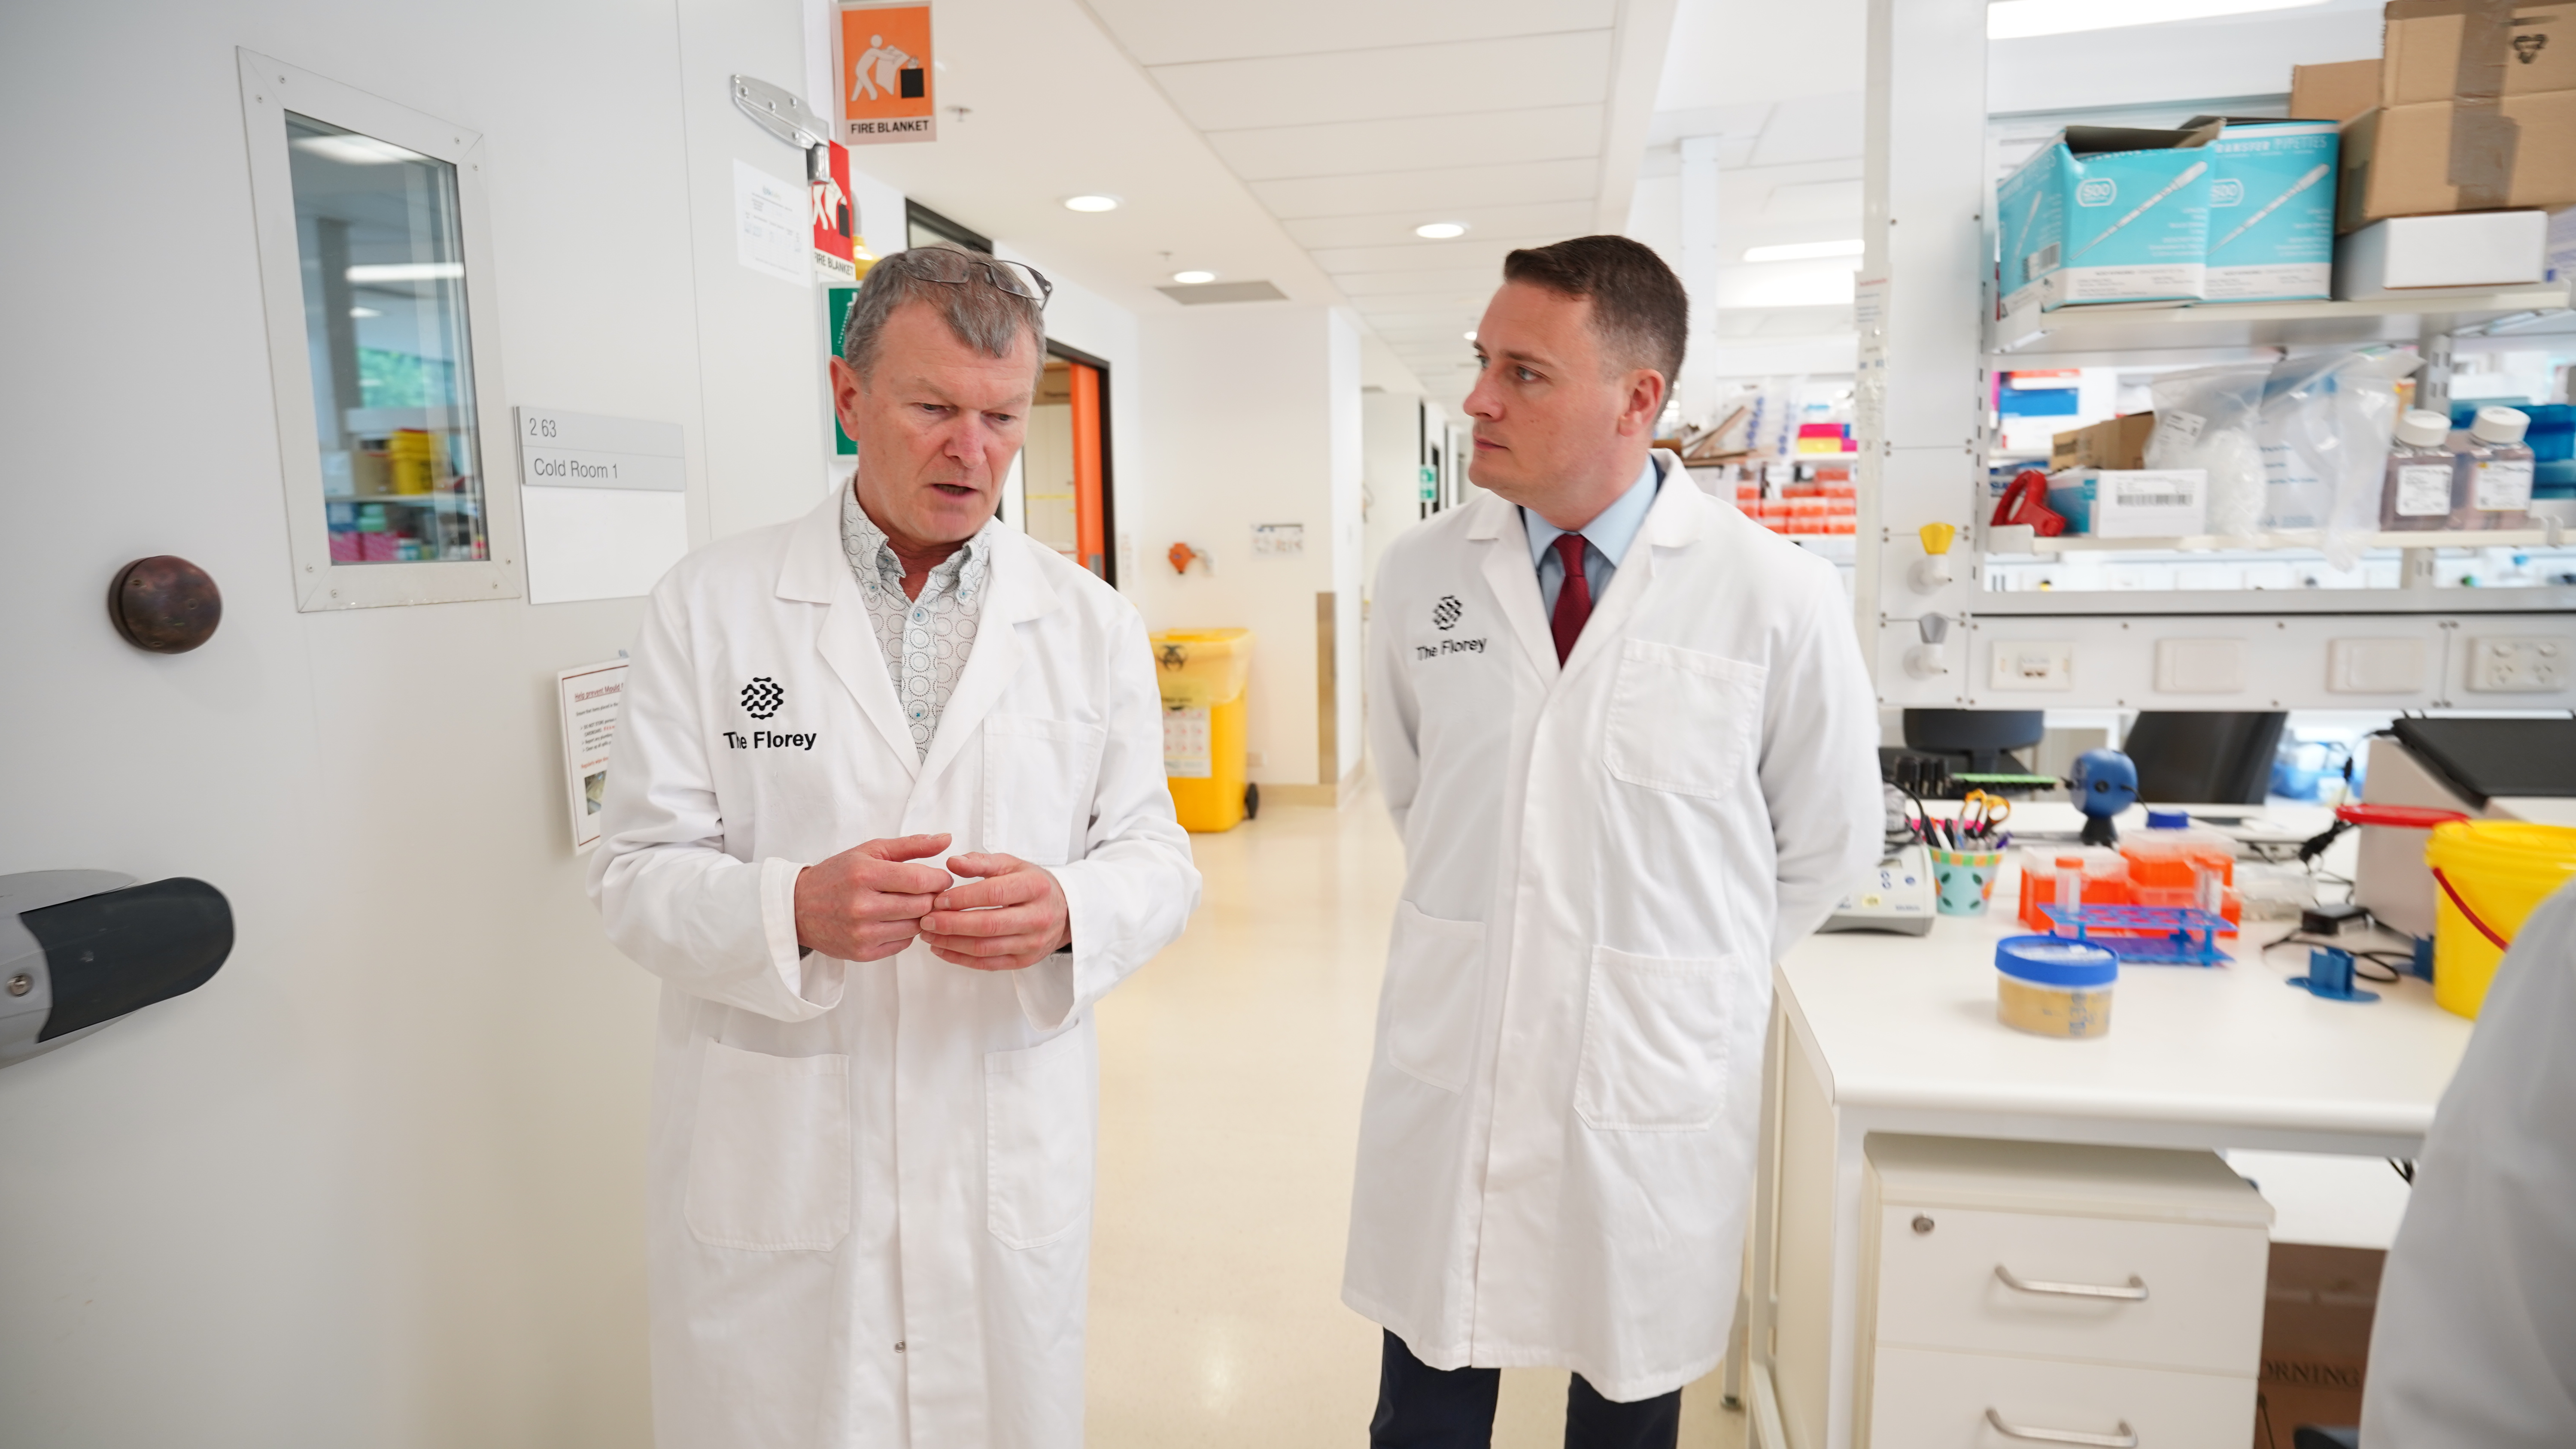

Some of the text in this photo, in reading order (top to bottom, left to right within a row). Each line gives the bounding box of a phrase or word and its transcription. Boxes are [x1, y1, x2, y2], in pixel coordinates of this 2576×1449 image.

[851, 120, 929, 134] FIRE BLANKET
[2215, 141, 2270, 153] RANSFER
[2273, 135, 2327, 150] PIPETTES
[2083, 183, 2110, 197] 500
[828, 257, 853, 276] BLANKET
[529, 418, 556, 437] 2 63
[534, 458, 617, 479] Cold Room 1
[1416, 638, 1487, 661] The Florey
[723, 731, 817, 751] The Florey
[2262, 1360, 2360, 1388] ORNING
